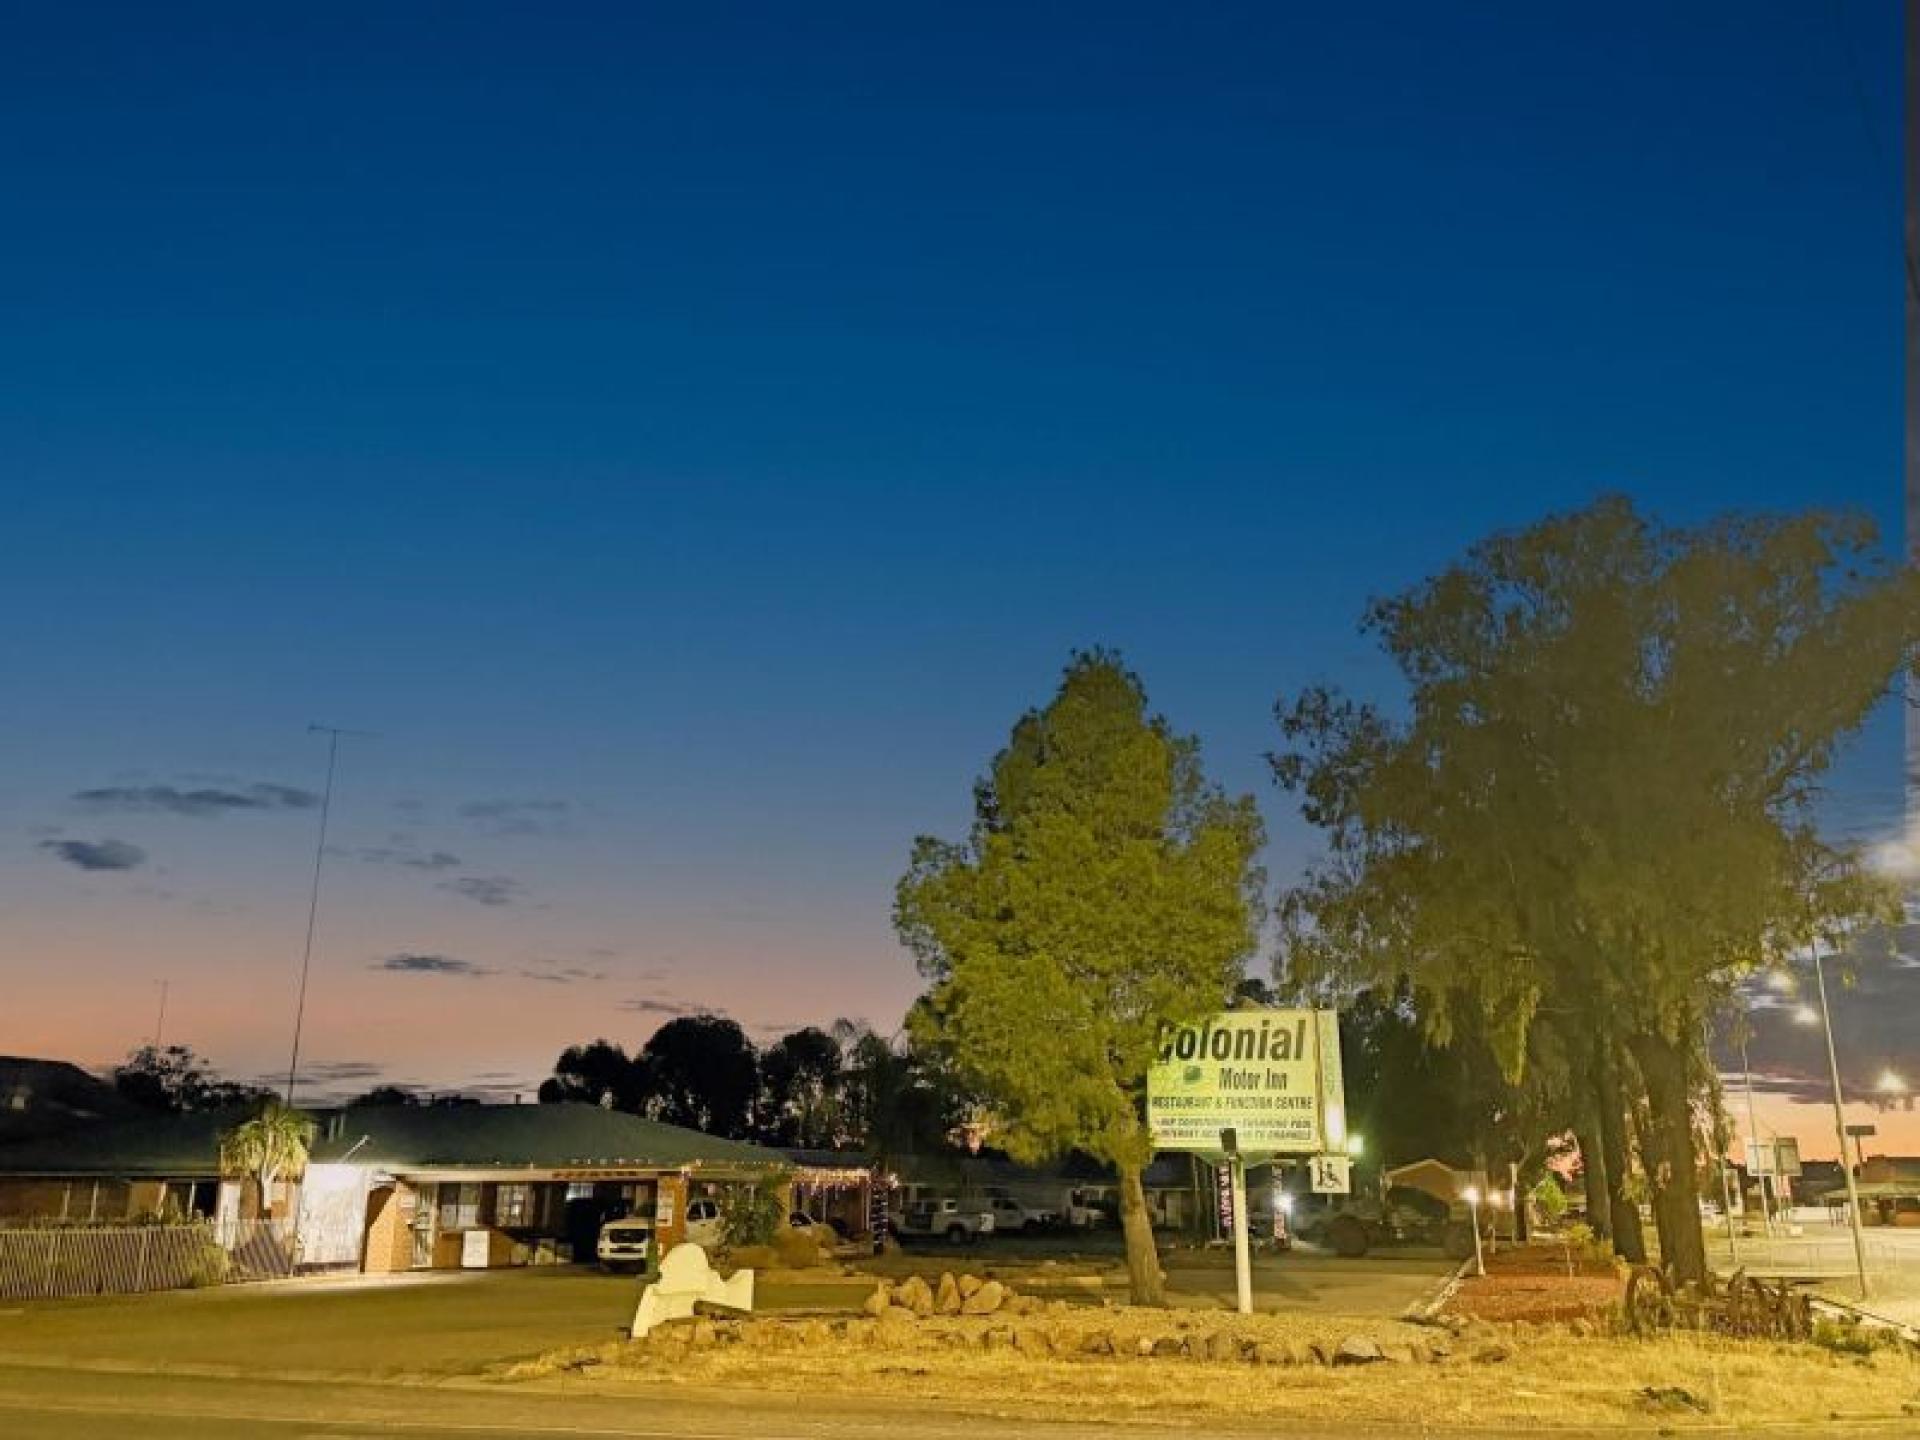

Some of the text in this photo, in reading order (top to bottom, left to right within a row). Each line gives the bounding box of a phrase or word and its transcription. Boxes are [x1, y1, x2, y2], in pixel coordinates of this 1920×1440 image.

[1156, 1019, 1306, 1061] Colonial
[1219, 1067, 1288, 1090] Motor Inn
[1276, 1097, 1313, 1109] CENTRE
